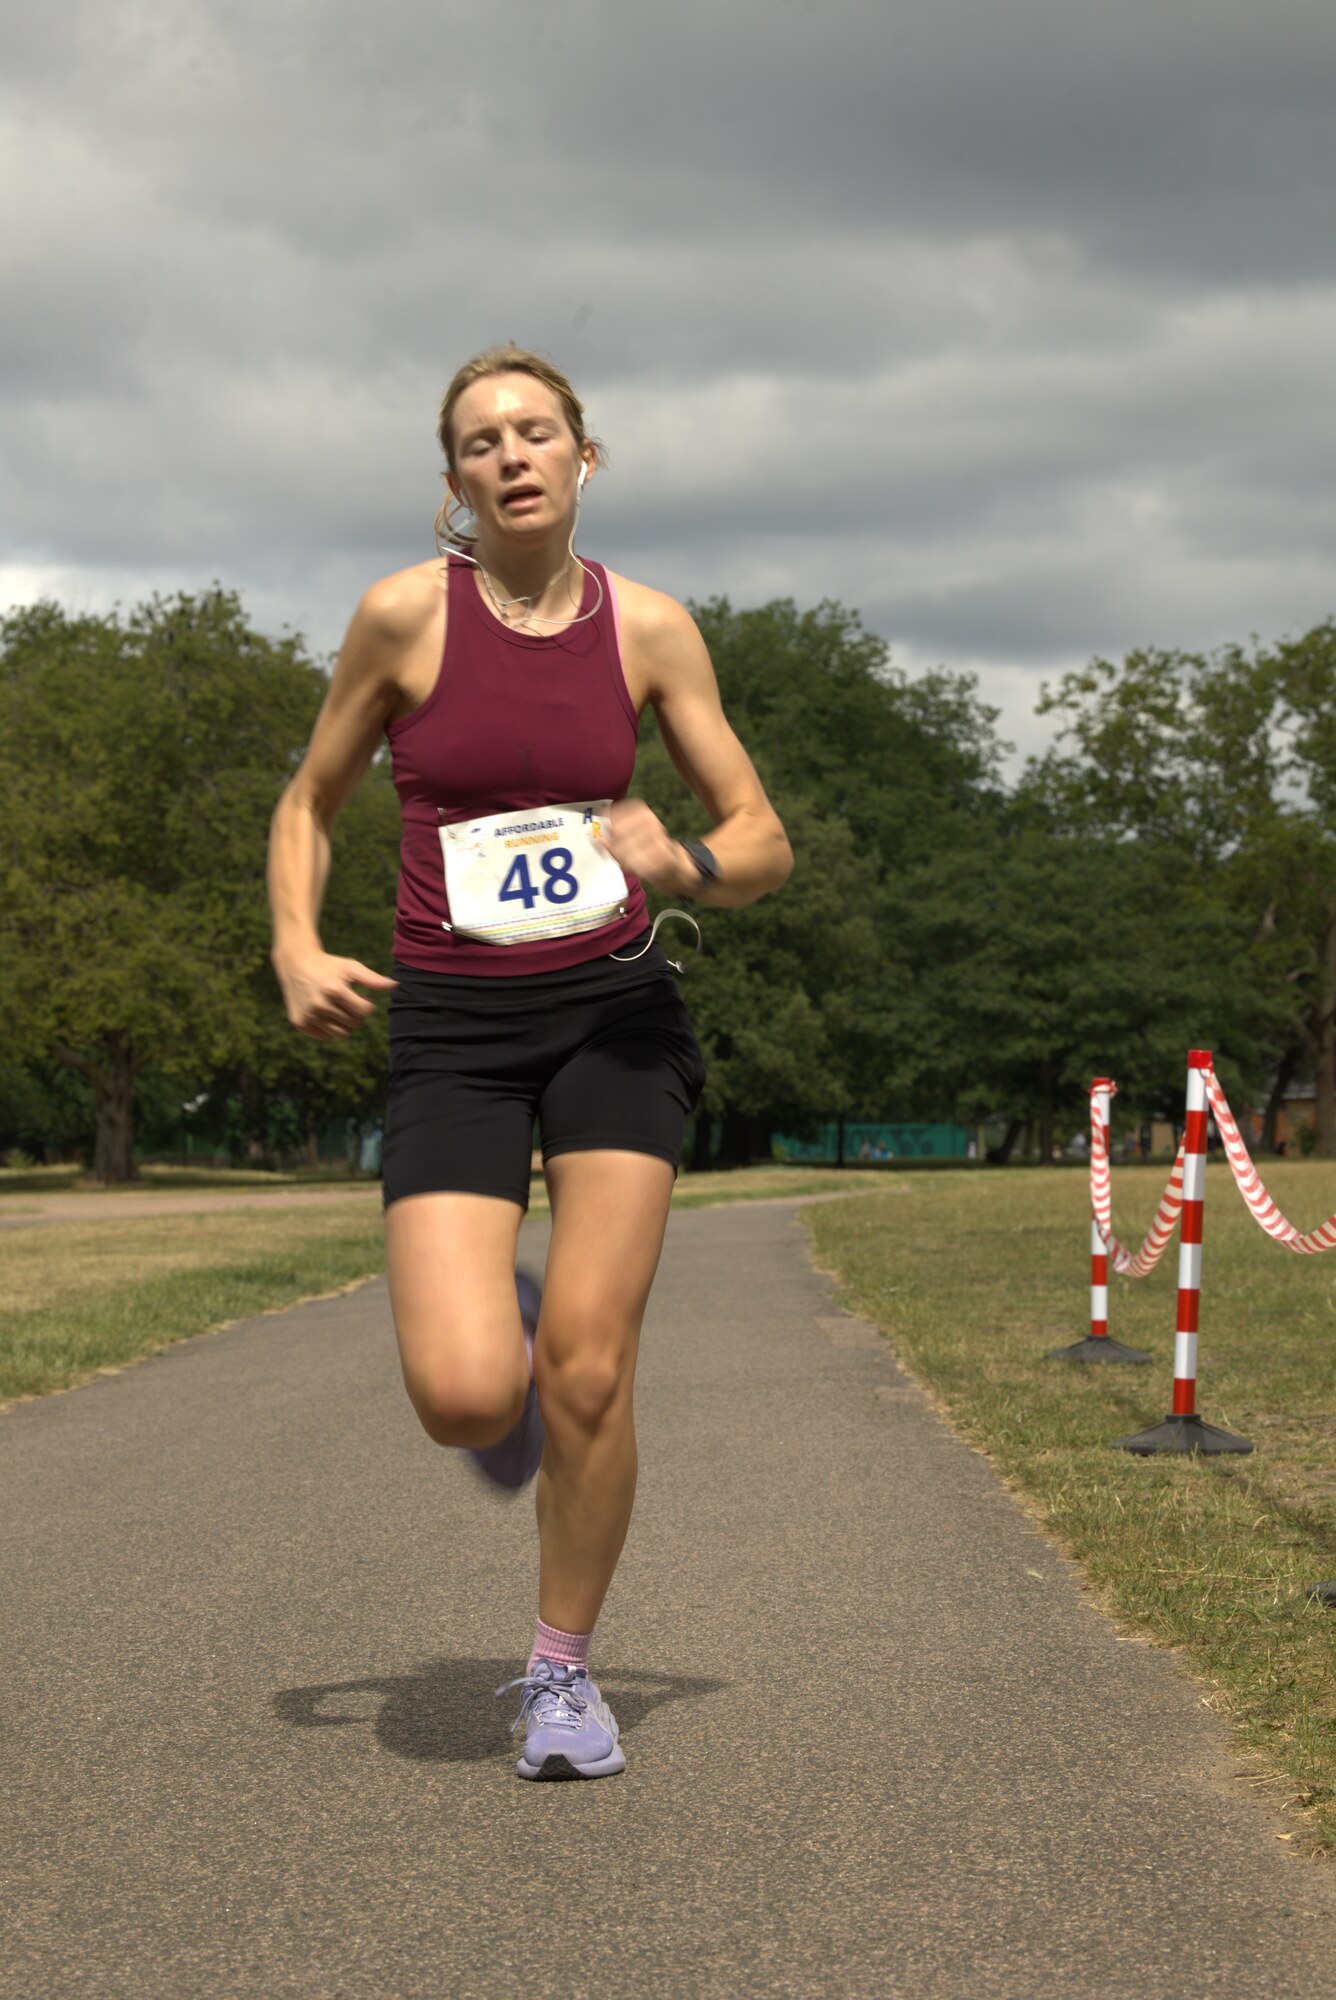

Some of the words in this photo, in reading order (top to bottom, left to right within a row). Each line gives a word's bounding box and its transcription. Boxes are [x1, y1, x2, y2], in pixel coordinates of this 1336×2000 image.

[494, 817, 564, 837] AFFORDABLE
[504, 832, 560, 848] RUNNING
[498, 847, 579, 909] 48
